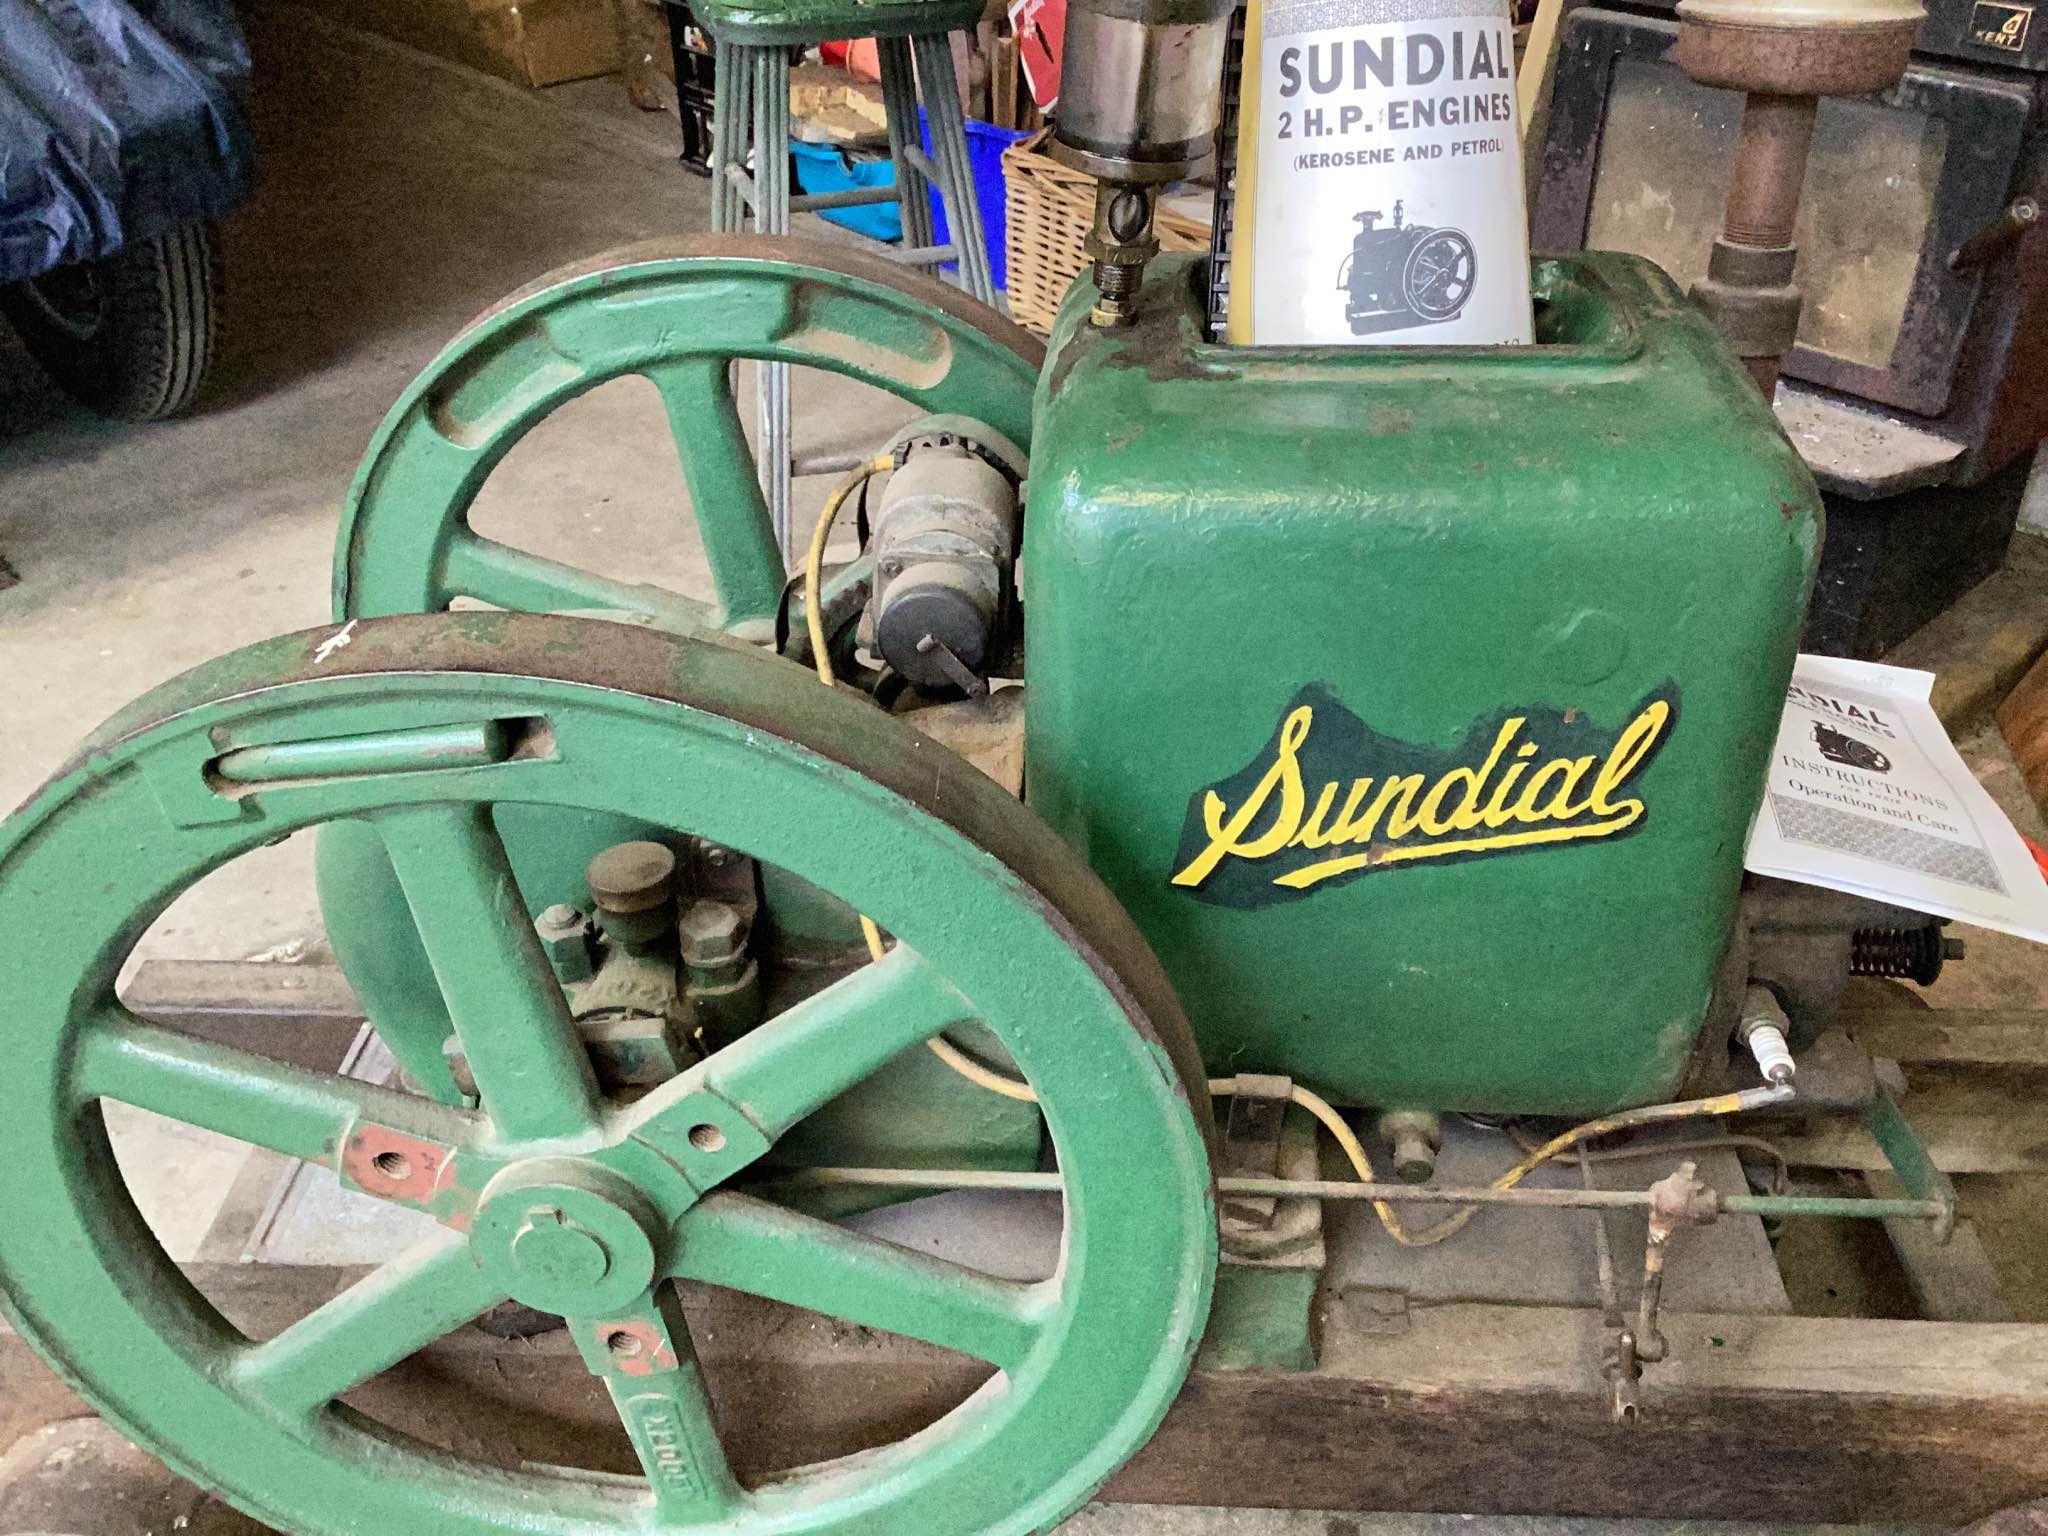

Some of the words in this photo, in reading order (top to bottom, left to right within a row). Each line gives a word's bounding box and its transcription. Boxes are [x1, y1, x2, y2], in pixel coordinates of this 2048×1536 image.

[1279, 30, 1510, 98] SUNDIAL
[1278, 111, 1293, 139] 2
[1303, 105, 1373, 137] H.P.
[1388, 93, 1511, 130] ENGINES
[1294, 148, 1395, 172] (KEROSENE
[1403, 144, 1443, 162] AND
[1171, 700, 1669, 887] Sundial
[1782, 755, 1949, 811] INSTRUCTIONS
[1788, 778, 1878, 812] Operation
[1882, 805, 1913, 823] and
[1917, 813, 1959, 834] Care
